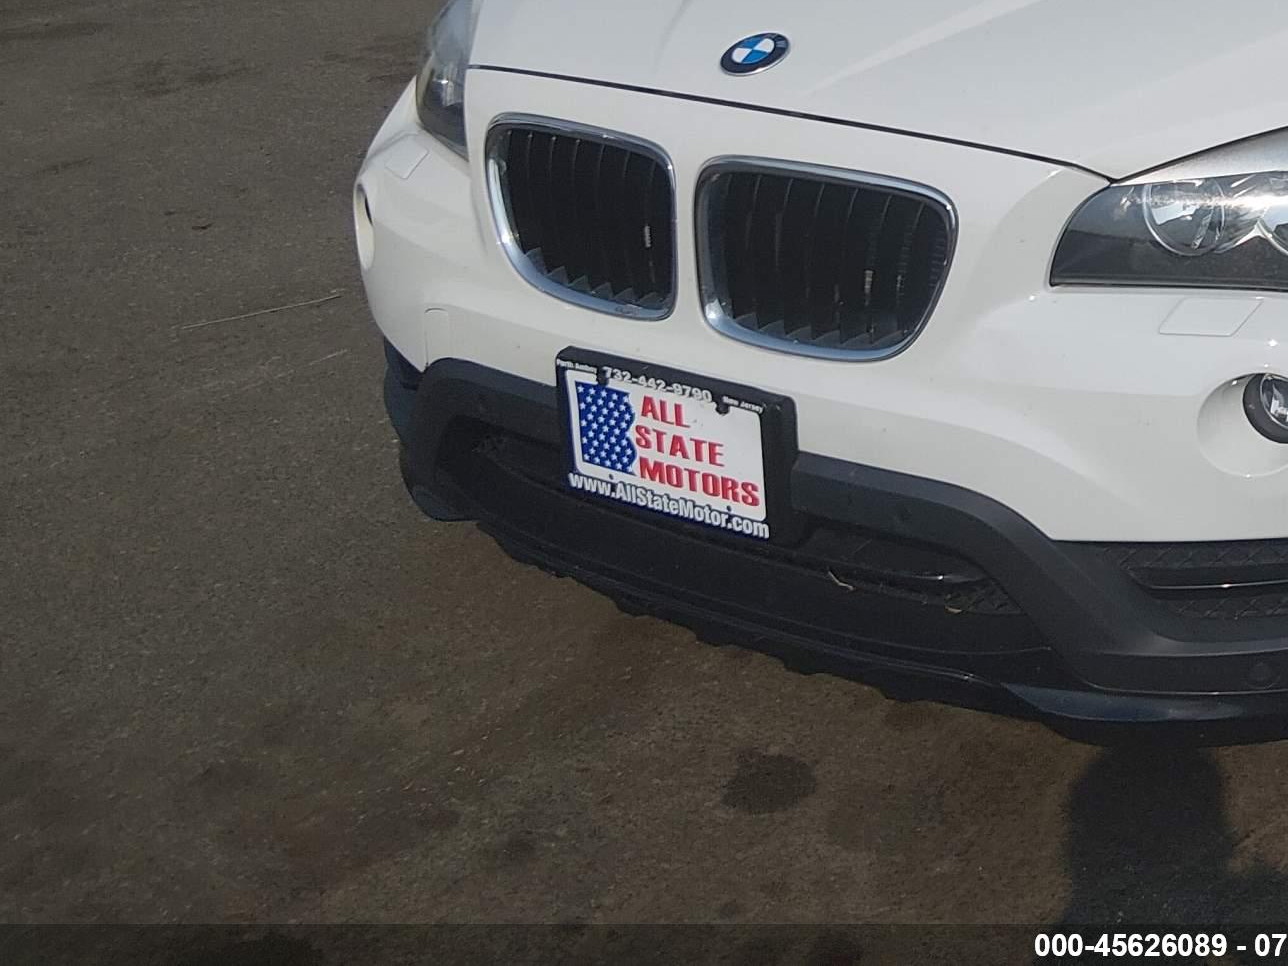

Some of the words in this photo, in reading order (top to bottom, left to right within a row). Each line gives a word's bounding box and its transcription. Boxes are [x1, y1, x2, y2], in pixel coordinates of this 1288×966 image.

[641, 395, 690, 429] ALL
[635, 425, 725, 467] STATE
[639, 456, 760, 507] MOTORS
[568, 472, 770, 540] www.AllStateMotor.com
